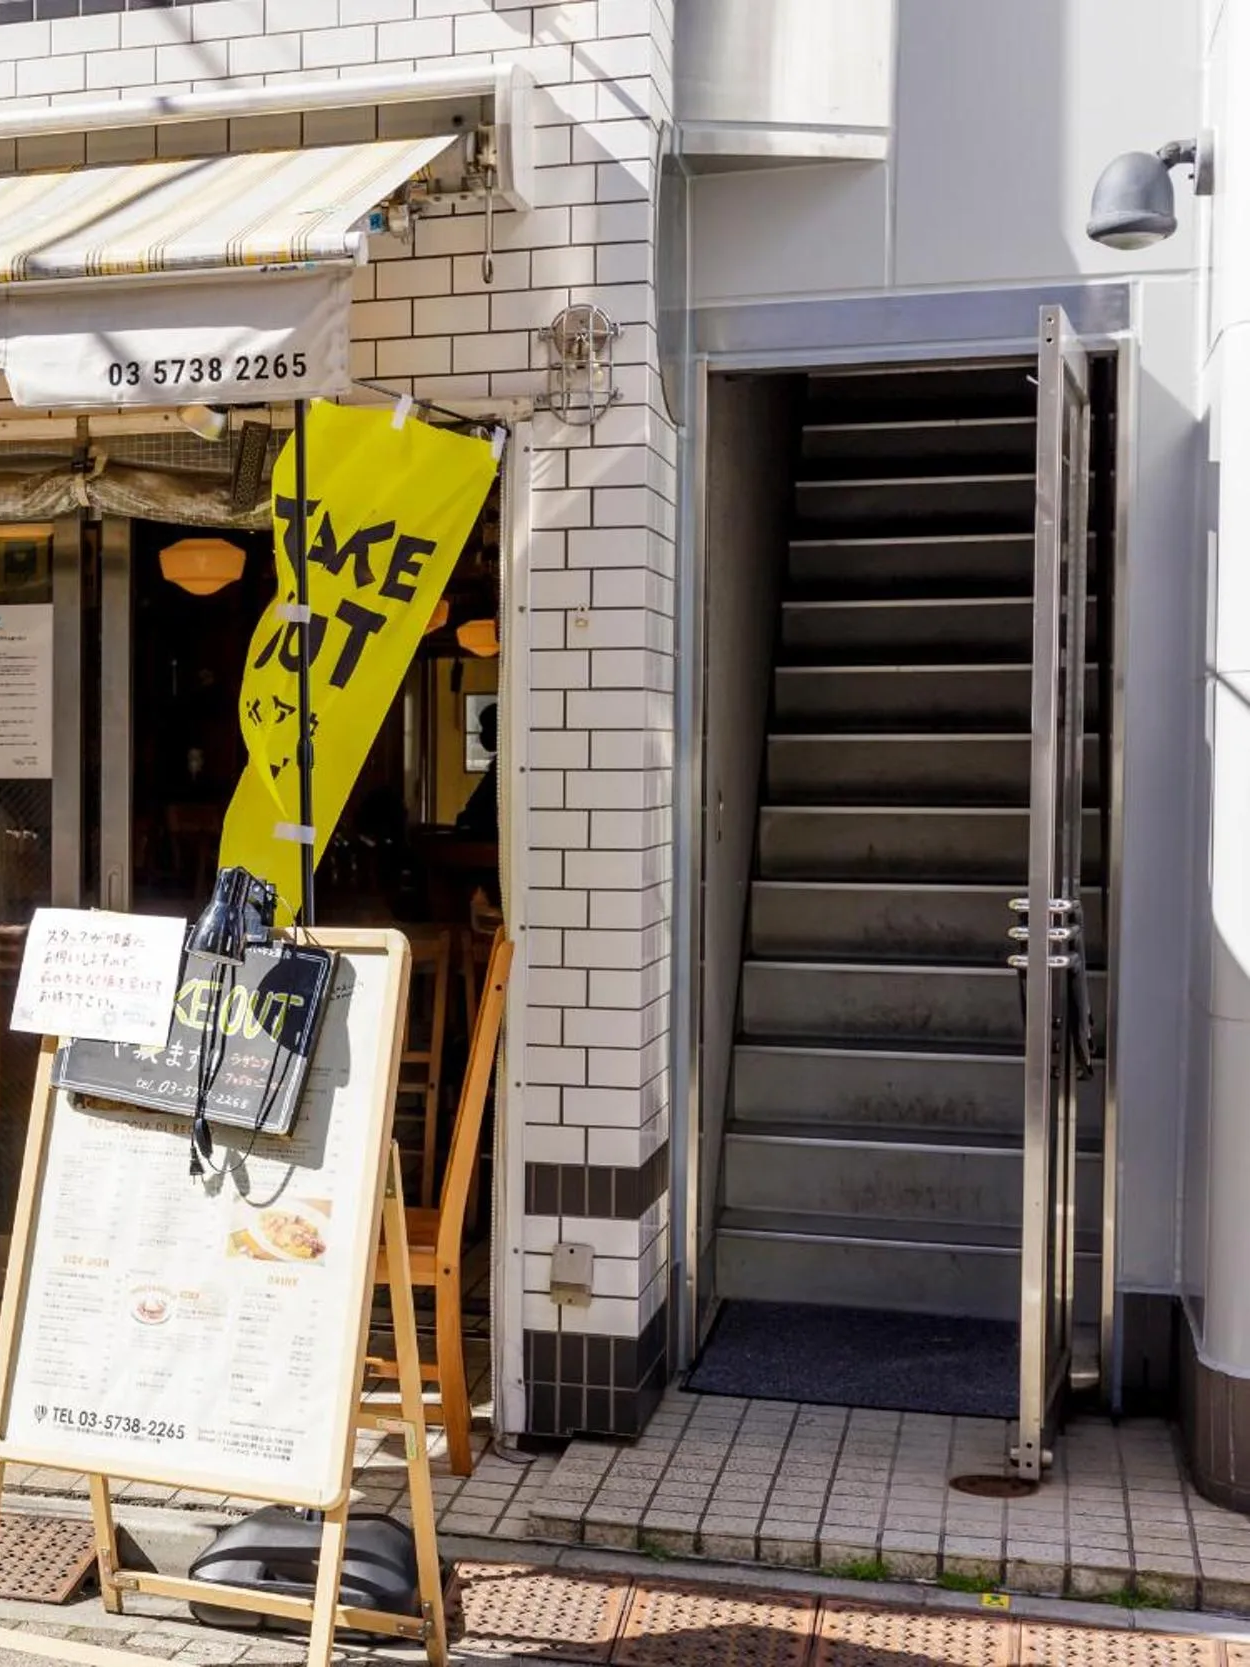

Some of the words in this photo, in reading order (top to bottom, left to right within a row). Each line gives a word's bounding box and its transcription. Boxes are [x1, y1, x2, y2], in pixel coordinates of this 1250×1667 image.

[109, 362, 140, 386] 03
[153, 358, 222, 384] 5738
[236, 353, 307, 381] 2265
[53, 1407, 75, 1425] TEL
[79, 1410, 186, 1440] 03-5738-2265
